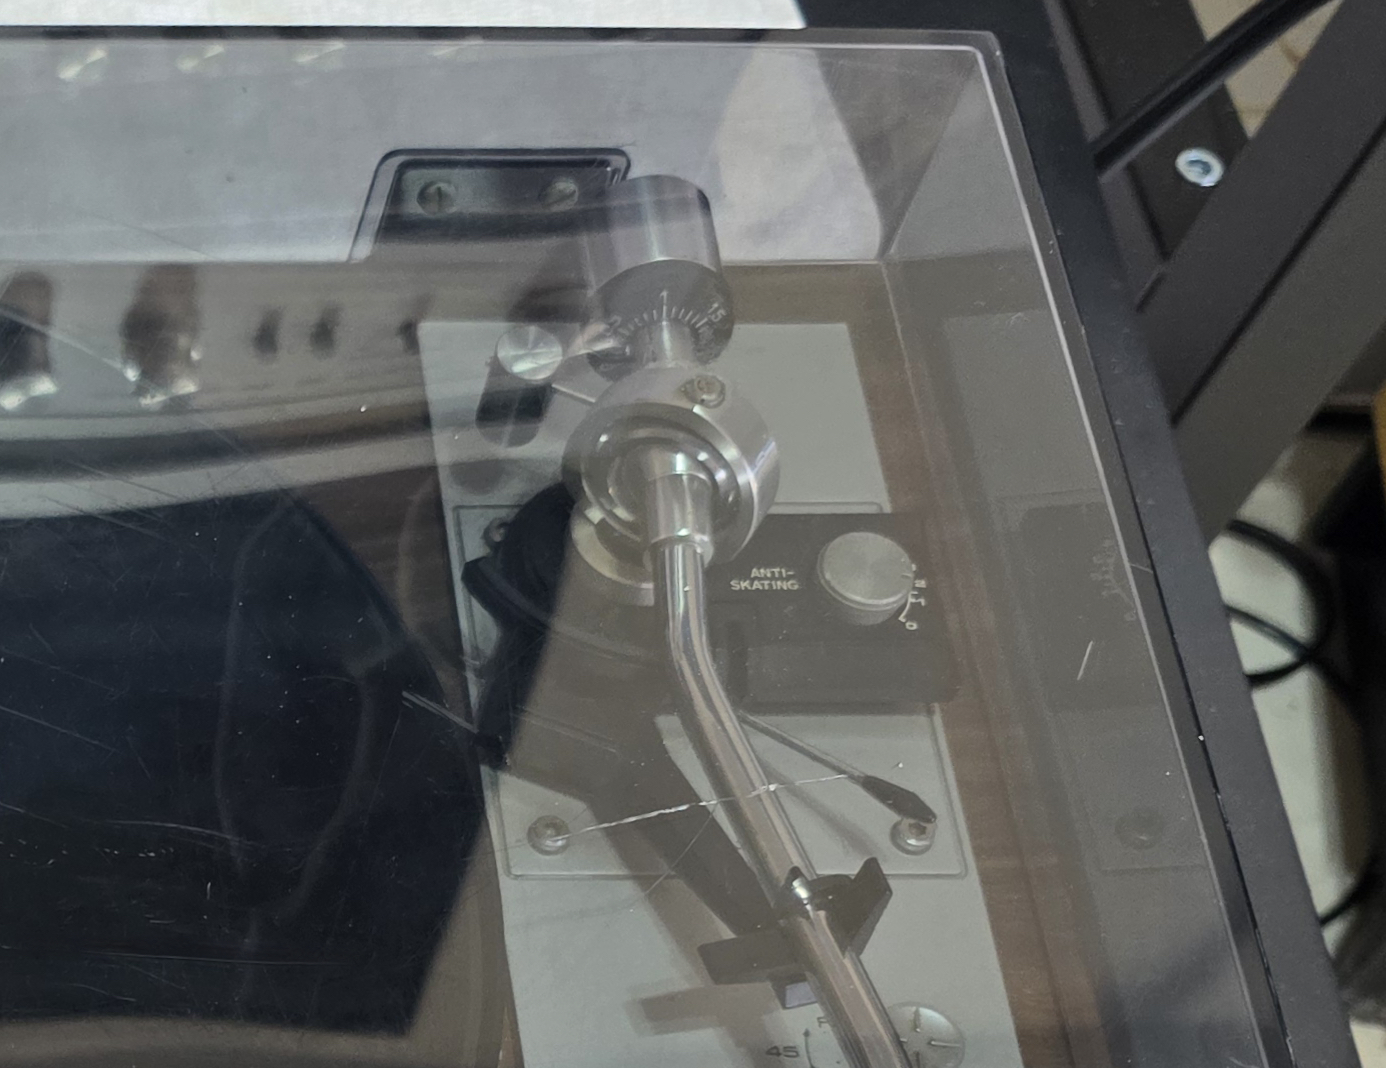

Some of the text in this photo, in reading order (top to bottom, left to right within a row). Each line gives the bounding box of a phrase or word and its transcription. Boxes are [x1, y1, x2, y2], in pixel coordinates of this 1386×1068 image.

[750, 567, 795, 578] ANTI-
[730, 580, 800, 591] SKATING
[766, 1045, 800, 1058] 45
